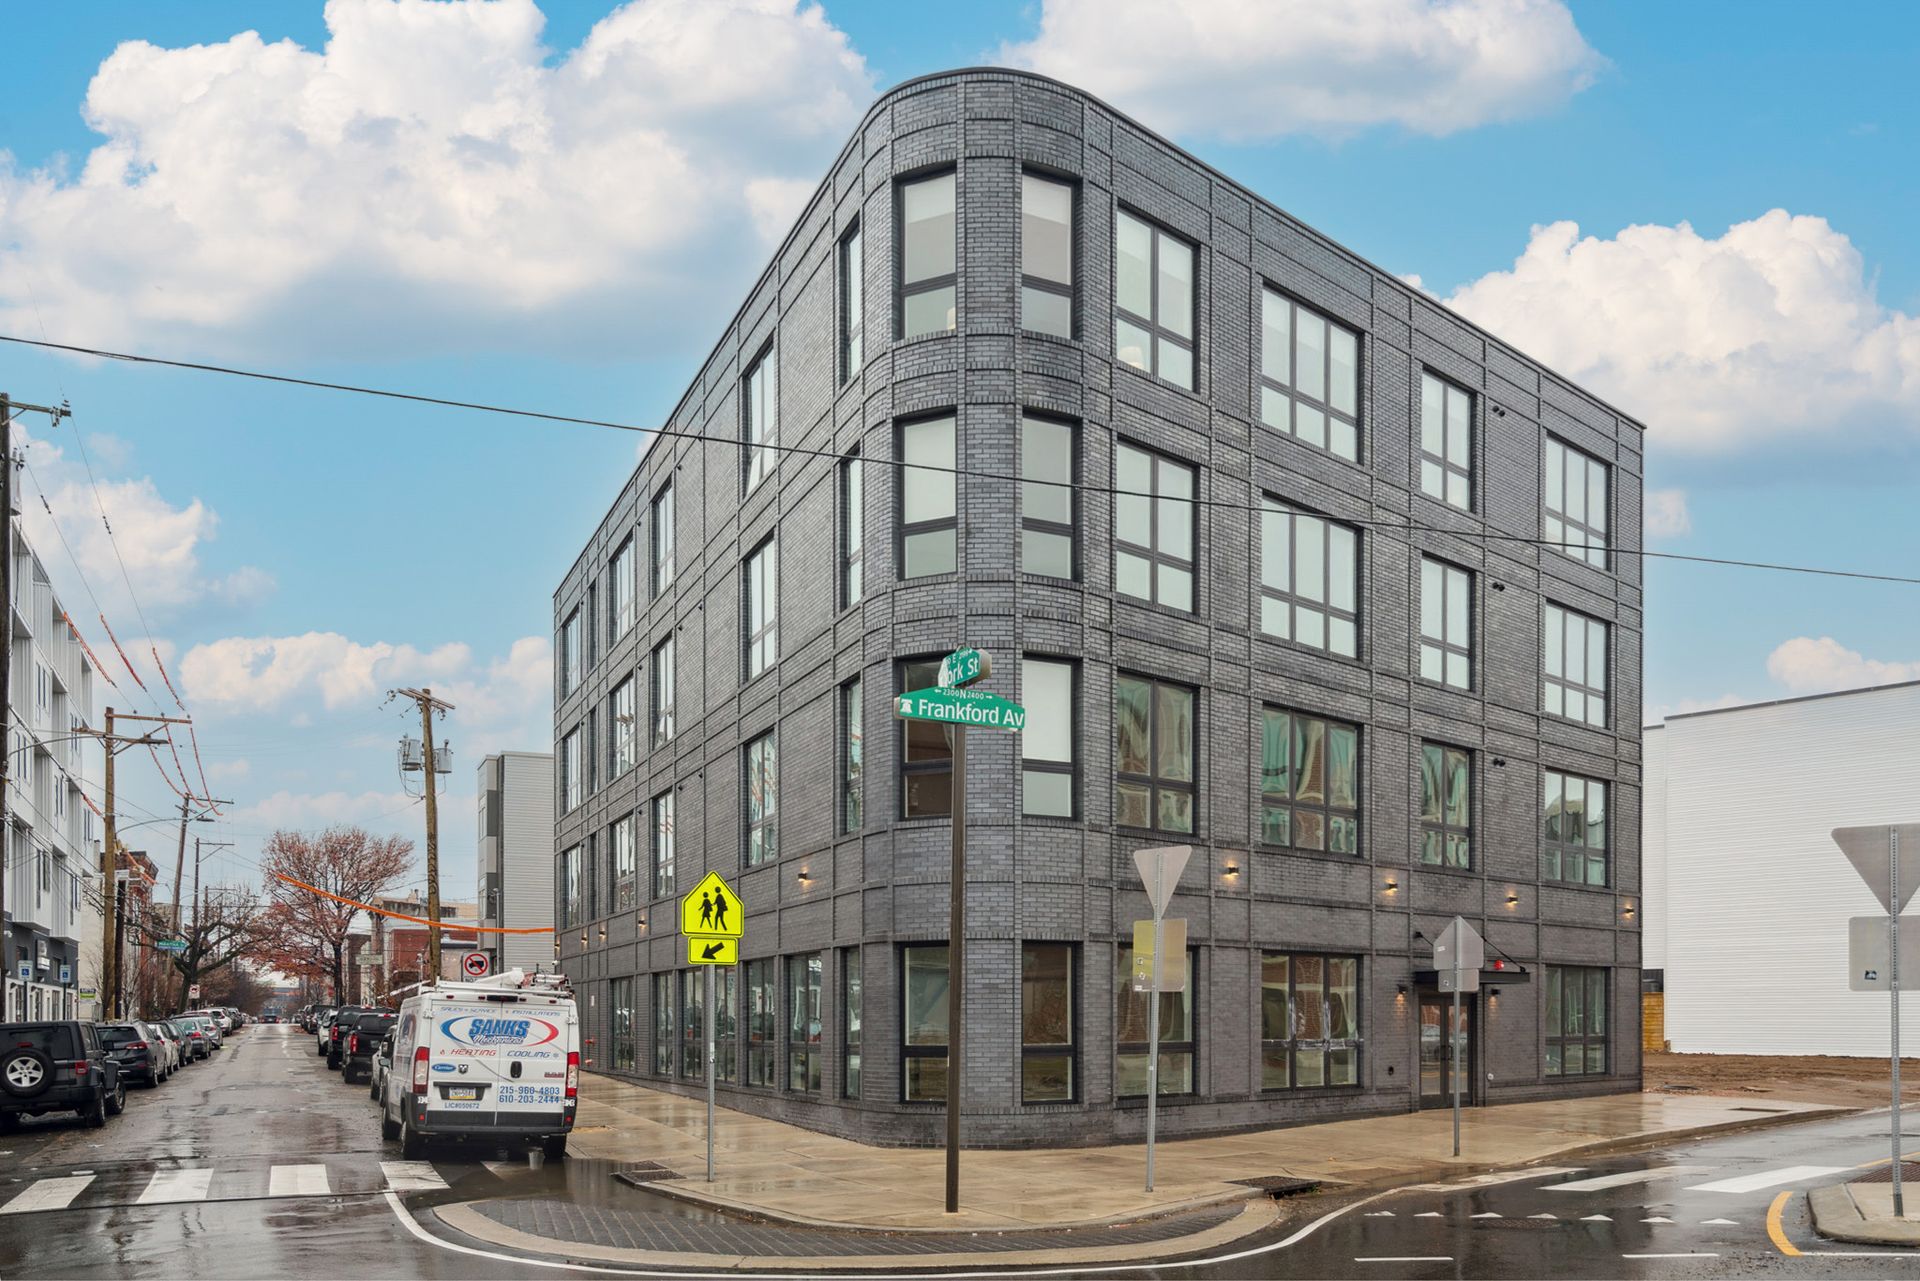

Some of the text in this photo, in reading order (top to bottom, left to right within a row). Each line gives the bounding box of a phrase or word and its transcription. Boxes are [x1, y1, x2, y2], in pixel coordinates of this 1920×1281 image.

[947, 661, 963, 684] ork
[967, 657, 978, 675] St
[943, 688, 984, 700] 2300 N 2400
[918, 699, 1024, 727] Frankford Av
[469, 1019, 531, 1038] SANKS
[450, 1048, 551, 1059] HEATING COOLING
[499, 1094, 560, 1104] 610-203-2444
